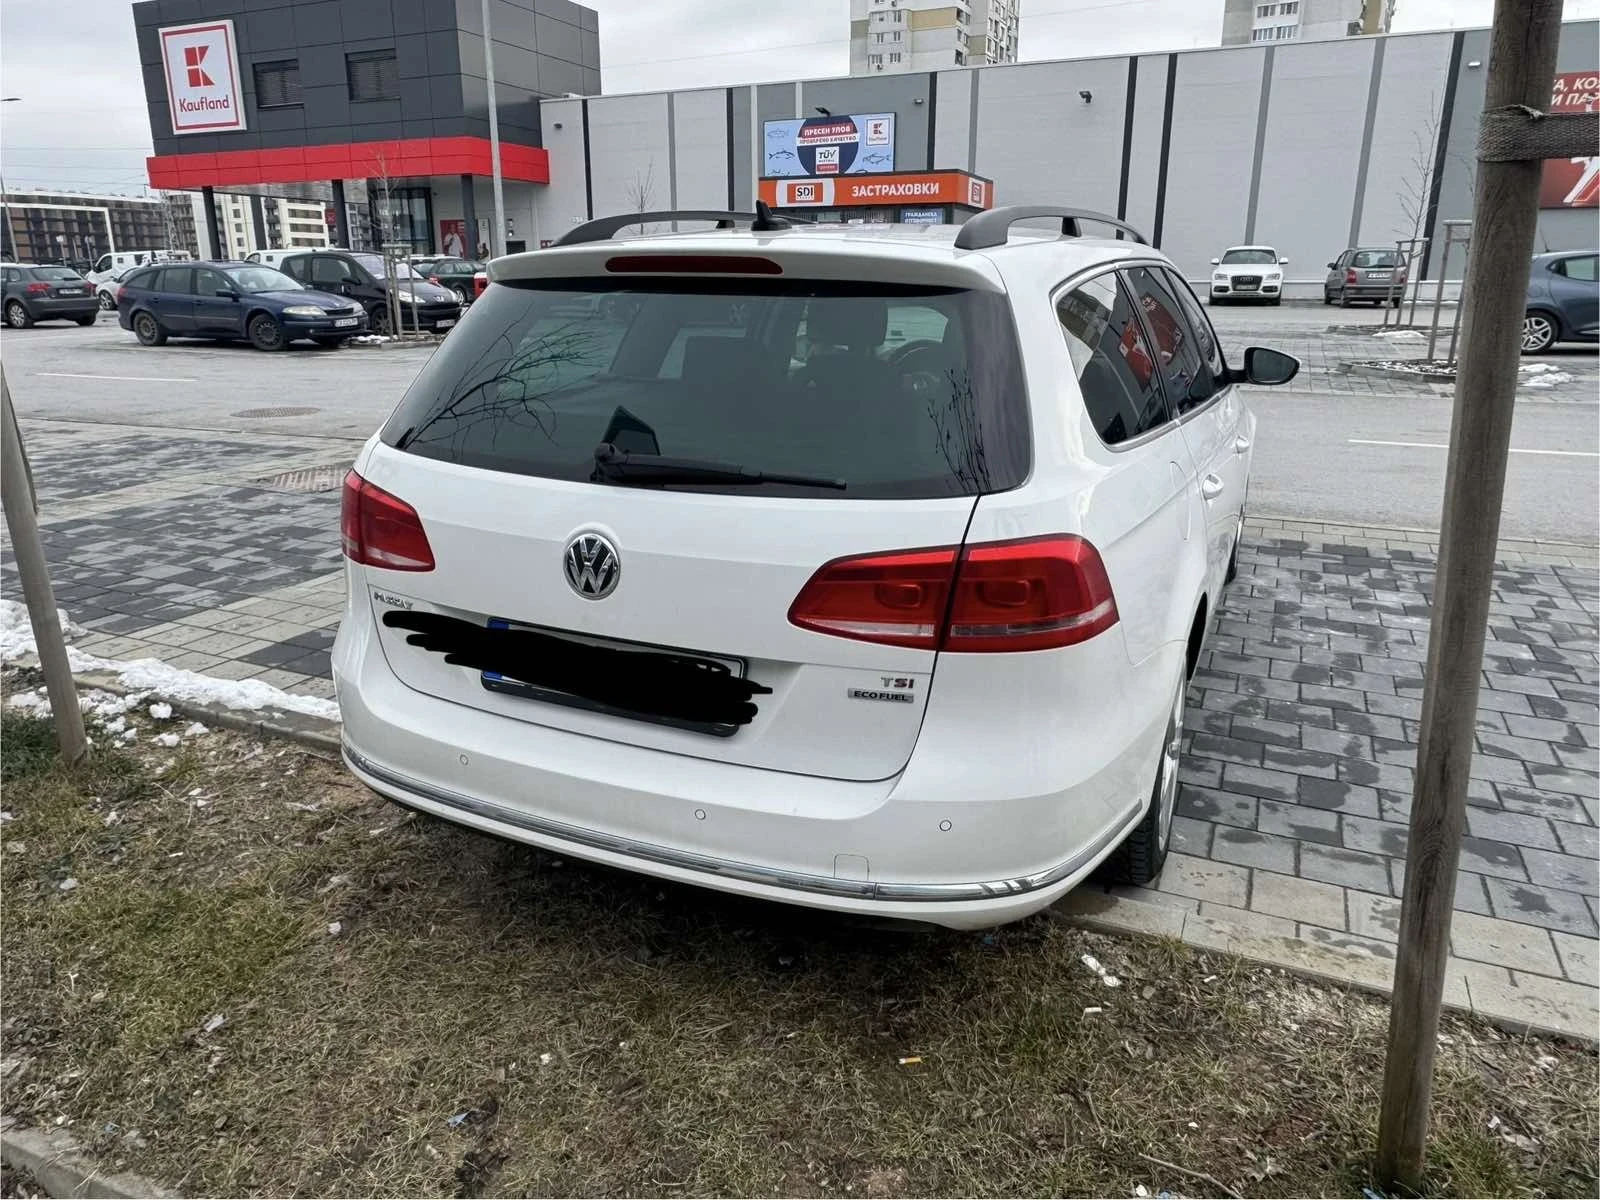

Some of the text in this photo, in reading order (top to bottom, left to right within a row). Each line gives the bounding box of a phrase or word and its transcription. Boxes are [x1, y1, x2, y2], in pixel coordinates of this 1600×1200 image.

[1553, 77, 1600, 92] А, КО
[179, 95, 230, 112] Kaufland
[804, 125, 851, 137] ПРЕСЕН УЛОВ
[818, 149, 837, 159] TÜV
[796, 186, 814, 197] SDI
[851, 182, 940, 197] ЗАСТРАХОВКИ
[881, 676, 915, 689] TSI
